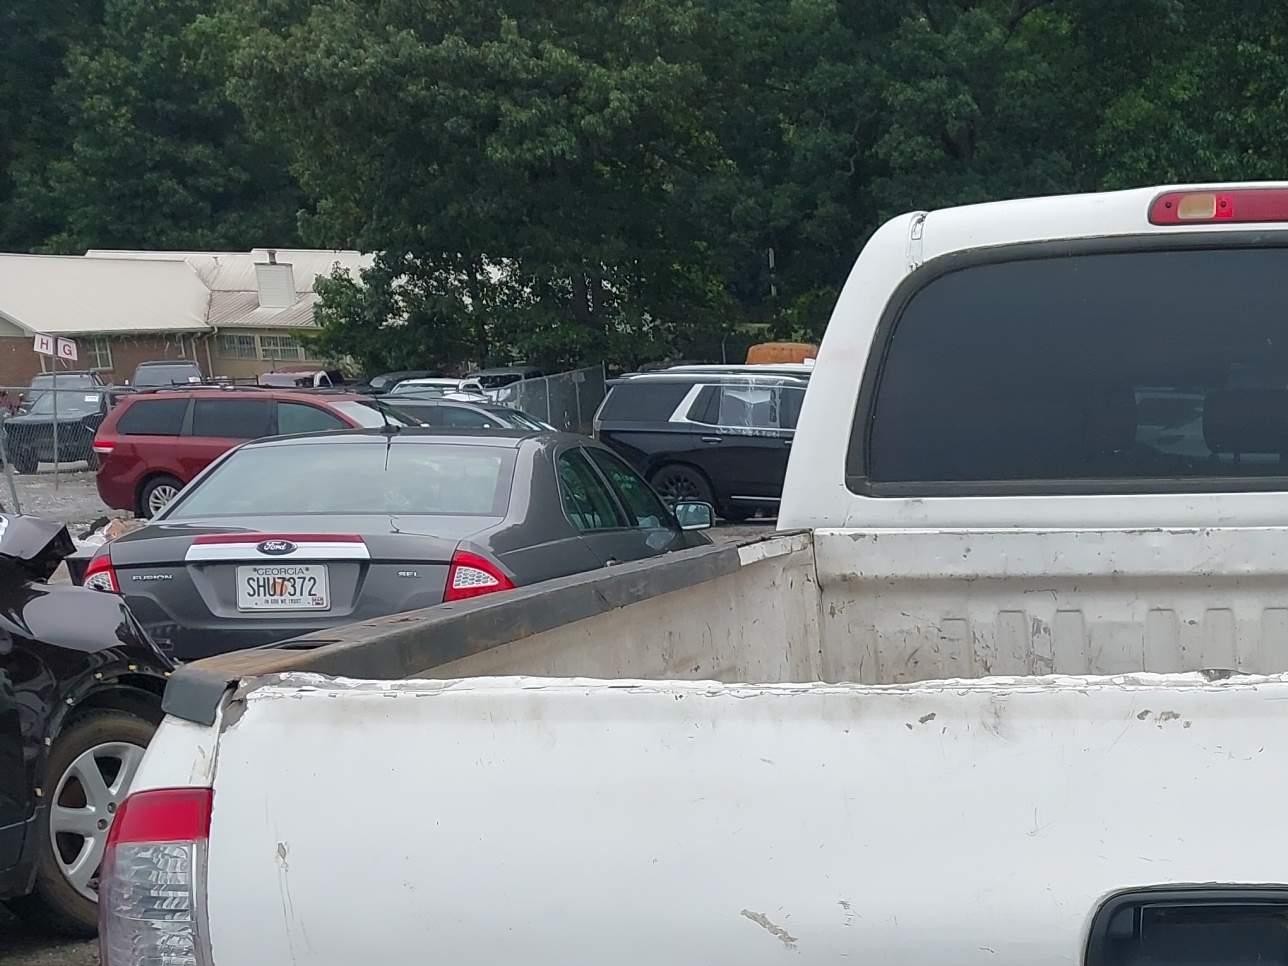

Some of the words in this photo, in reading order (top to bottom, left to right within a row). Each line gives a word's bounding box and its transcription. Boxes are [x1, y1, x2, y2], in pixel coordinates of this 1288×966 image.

[40, 338, 49, 350] H
[63, 344, 73, 357] G
[256, 567, 305, 576] GEORGIA
[246, 576, 317, 597] SHU7372
